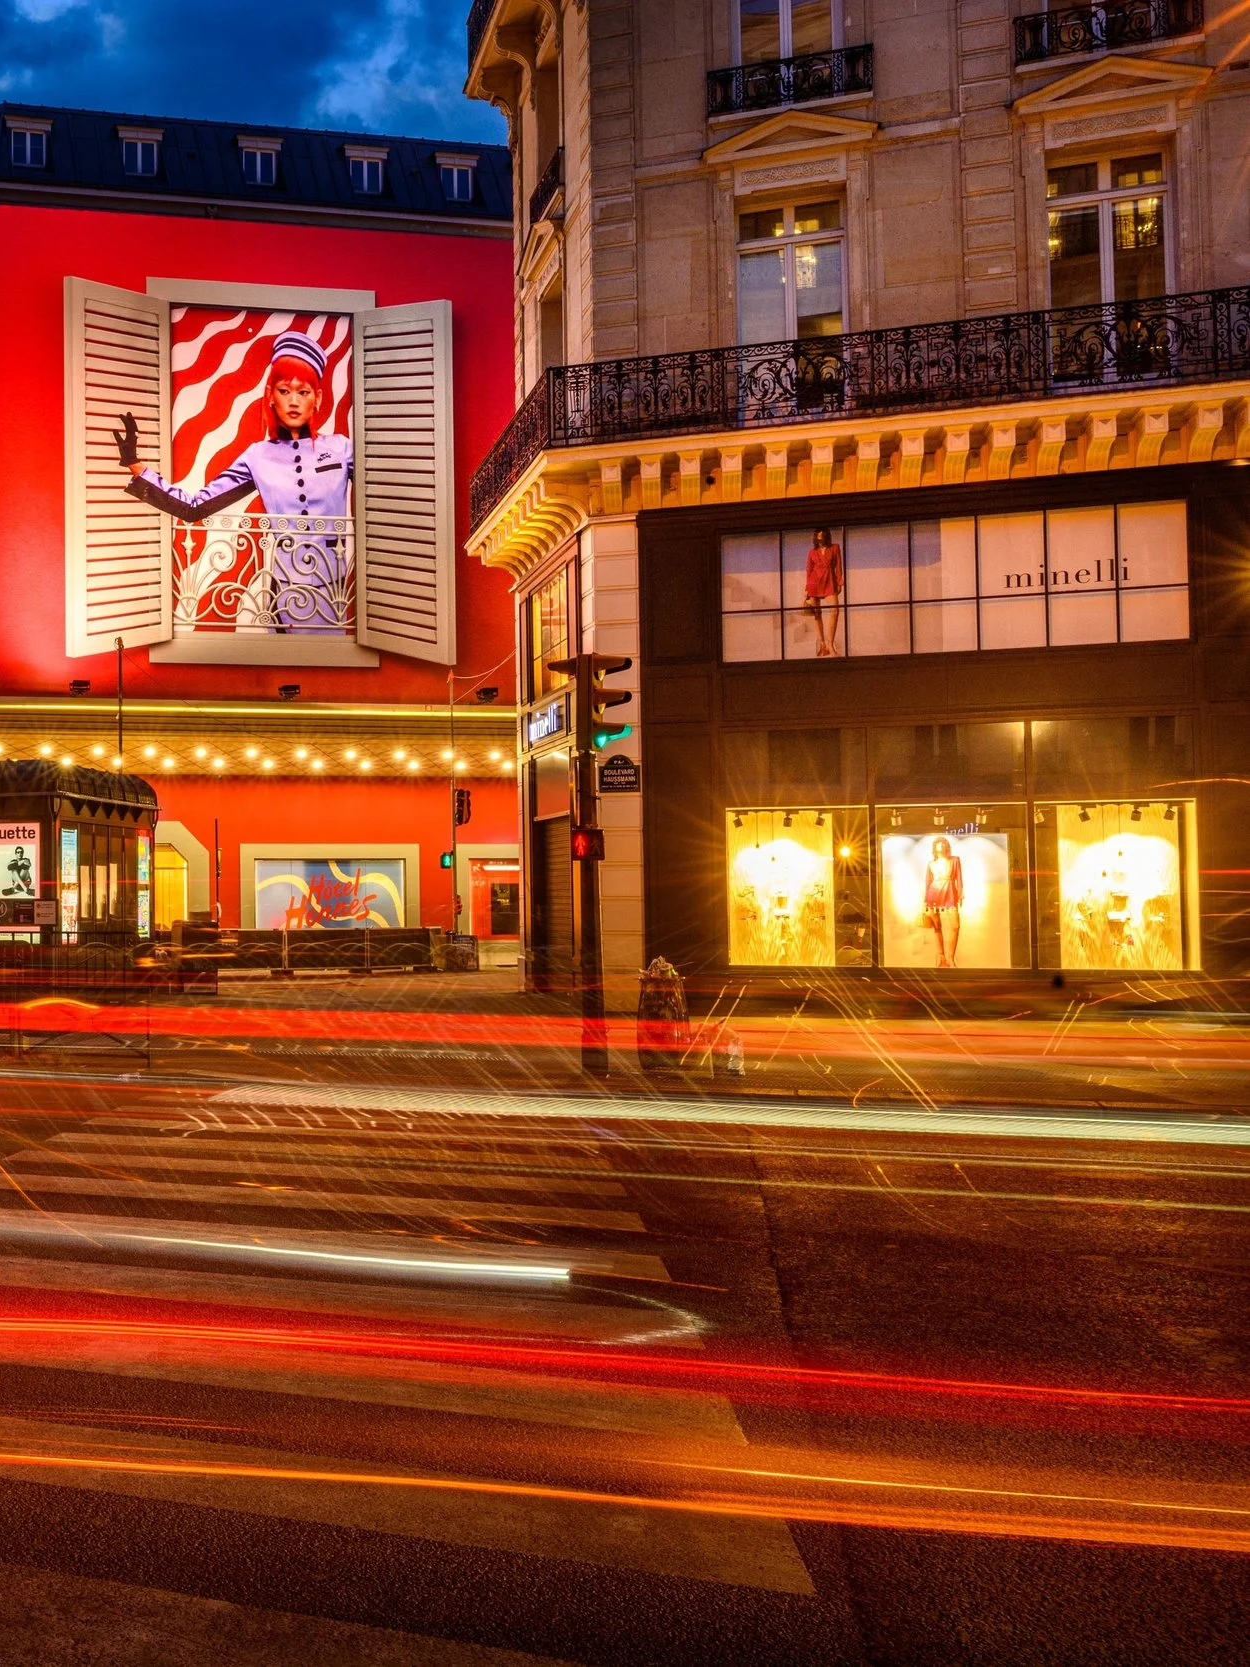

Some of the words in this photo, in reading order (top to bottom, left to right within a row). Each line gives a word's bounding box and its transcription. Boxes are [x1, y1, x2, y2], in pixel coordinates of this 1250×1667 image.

[1003, 558, 1130, 588] minelli
[529, 703, 558, 742] minelli
[945, 822, 979, 834] inelli
[285, 894, 378, 929] Hennes
